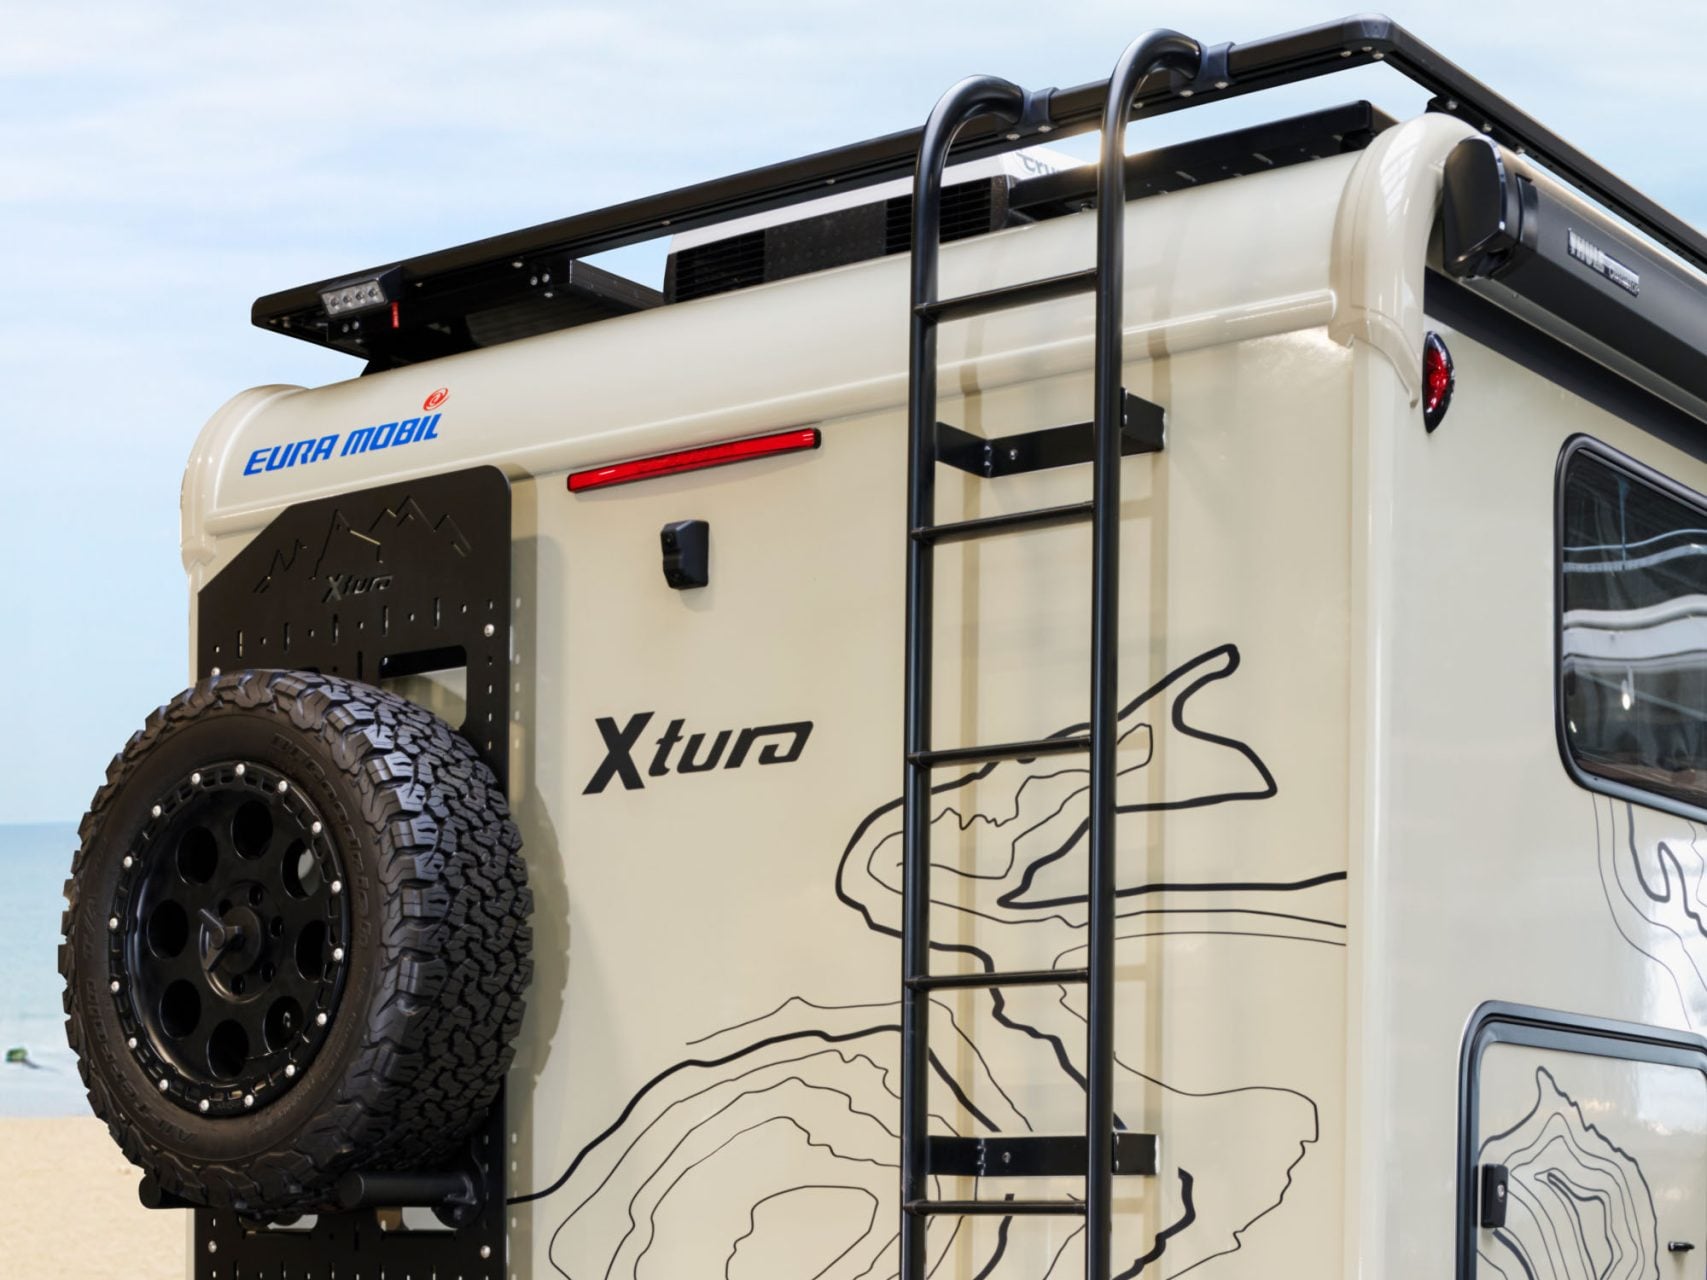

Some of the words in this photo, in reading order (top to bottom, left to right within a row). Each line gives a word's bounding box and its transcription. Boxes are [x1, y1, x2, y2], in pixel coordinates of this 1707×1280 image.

[243, 434, 340, 476] EURA
[340, 413, 442, 457] MOBIL
[321, 573, 393, 603] Xtura
[582, 711, 814, 795] Xtura
